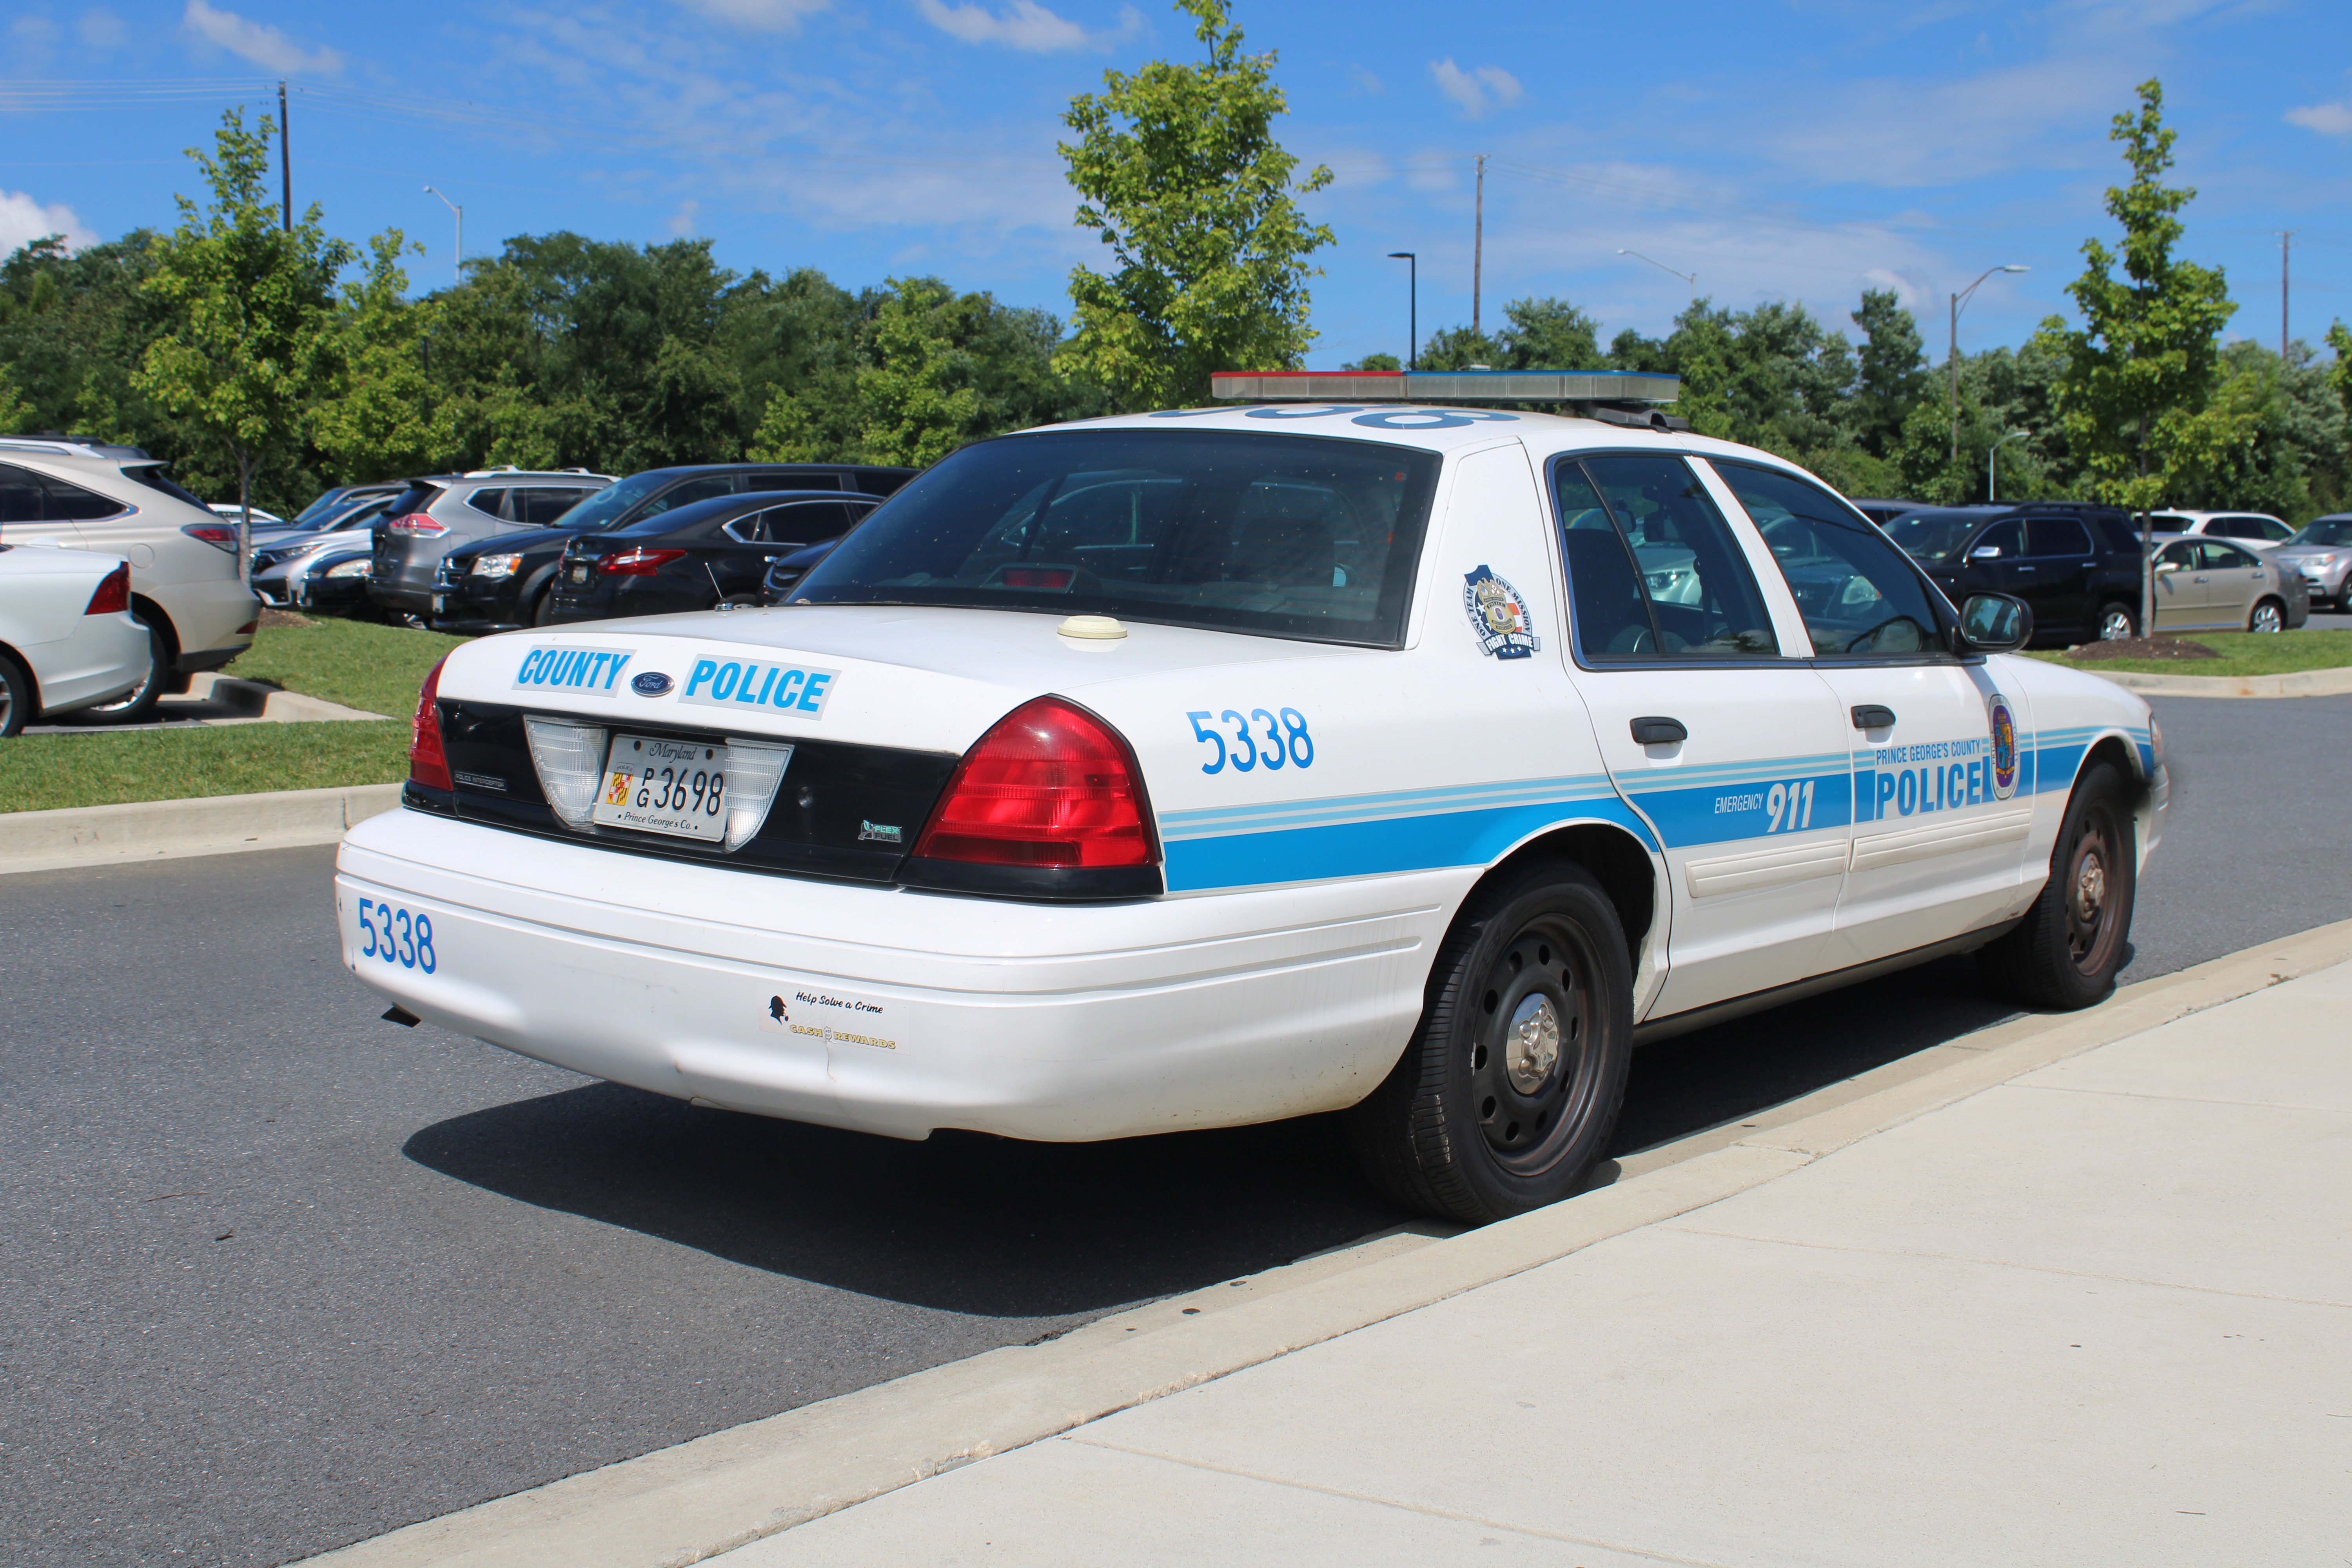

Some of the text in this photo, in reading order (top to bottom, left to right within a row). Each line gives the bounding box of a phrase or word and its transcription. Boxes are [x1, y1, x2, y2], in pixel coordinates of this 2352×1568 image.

[1466, 587, 1486, 636] ONE TEAM
[1496, 578, 1530, 633] ONE MISSION
[1485, 633, 1533, 652] FIGHT CRIME
[518, 650, 631, 690] COUNTY
[638, 675, 663, 689] Ford
[685, 660, 831, 712] POLICE
[649, 743, 697, 763] Maryland
[1186, 707, 1314, 775] 5338
[1876, 739, 1980, 765] PRINCE GEORGE'S COUNTY
[472, 777, 505, 787] INTERCEPTOR
[642, 767, 655, 786] P
[637, 788, 650, 808] G
[655, 767, 724, 816] 3698
[1876, 762, 1982, 820] POLICE
[1715, 780, 1815, 833] EMERGENCY 911
[624, 812, 691, 829] Prince George's Co.
[875, 826, 899, 834] FLEX
[359, 897, 436, 974] 5338
[796, 992, 817, 1005] Help
[819, 995, 843, 1007] Solve
[855, 1001, 884, 1014] Crime
[789, 1024, 823, 1038] CASH
[834, 1031, 896, 1049] REWARDS
